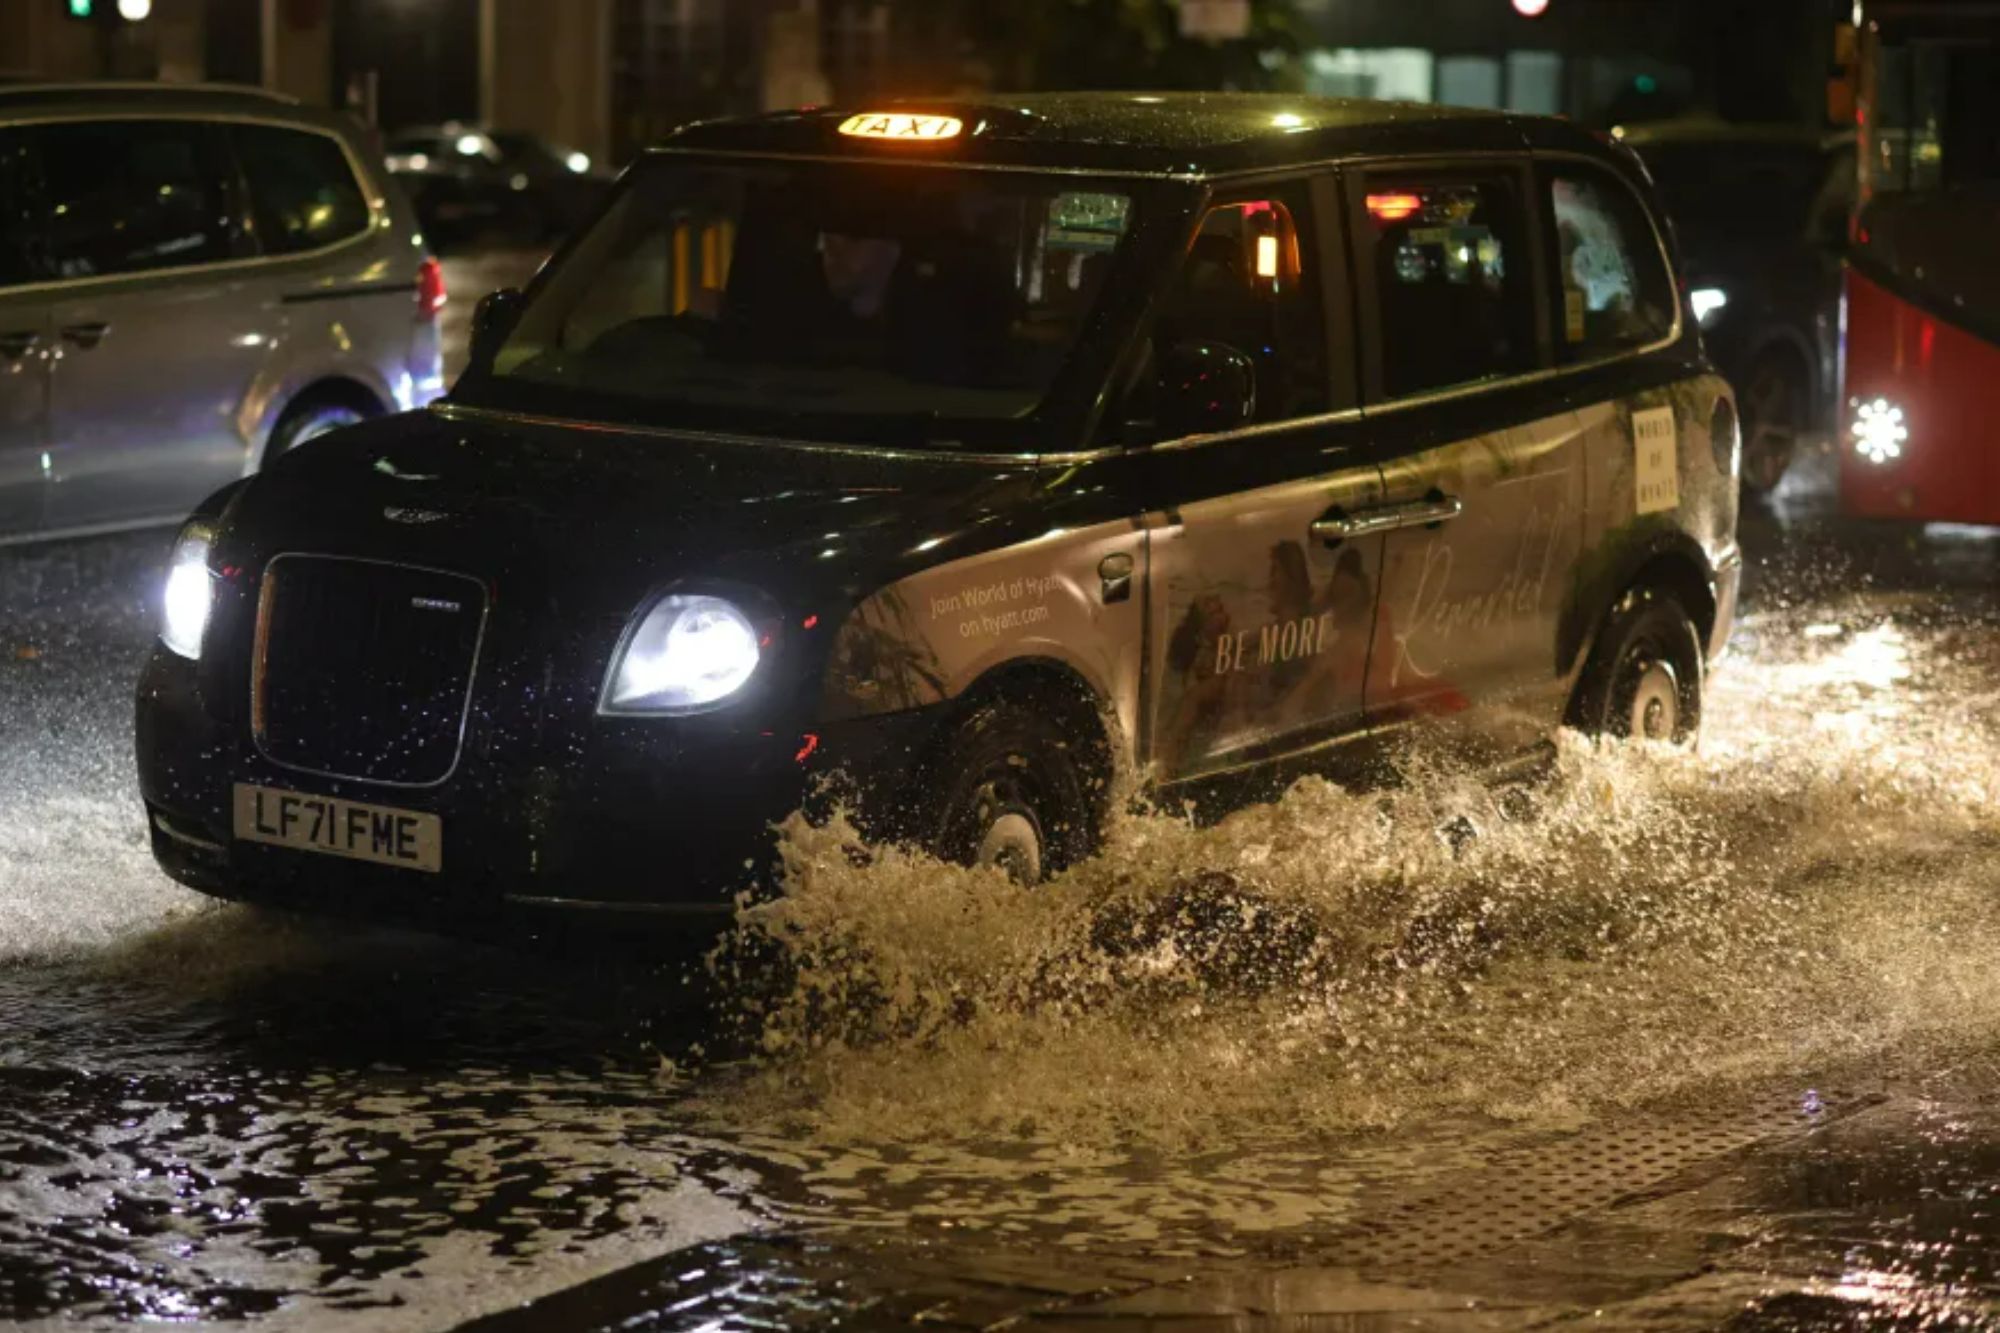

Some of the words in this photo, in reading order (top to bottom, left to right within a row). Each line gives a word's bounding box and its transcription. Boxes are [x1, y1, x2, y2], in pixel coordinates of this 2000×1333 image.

[852, 116, 949, 135] TAXI
[930, 594, 961, 620] Join
[962, 581, 1007, 607] World
[1010, 577, 1024, 600] of
[959, 619, 980, 638] on
[981, 605, 1050, 637] hyatt.com
[1214, 628, 1249, 676] BE
[1259, 612, 1333, 665] MORE
[347, 807, 419, 860] FME
